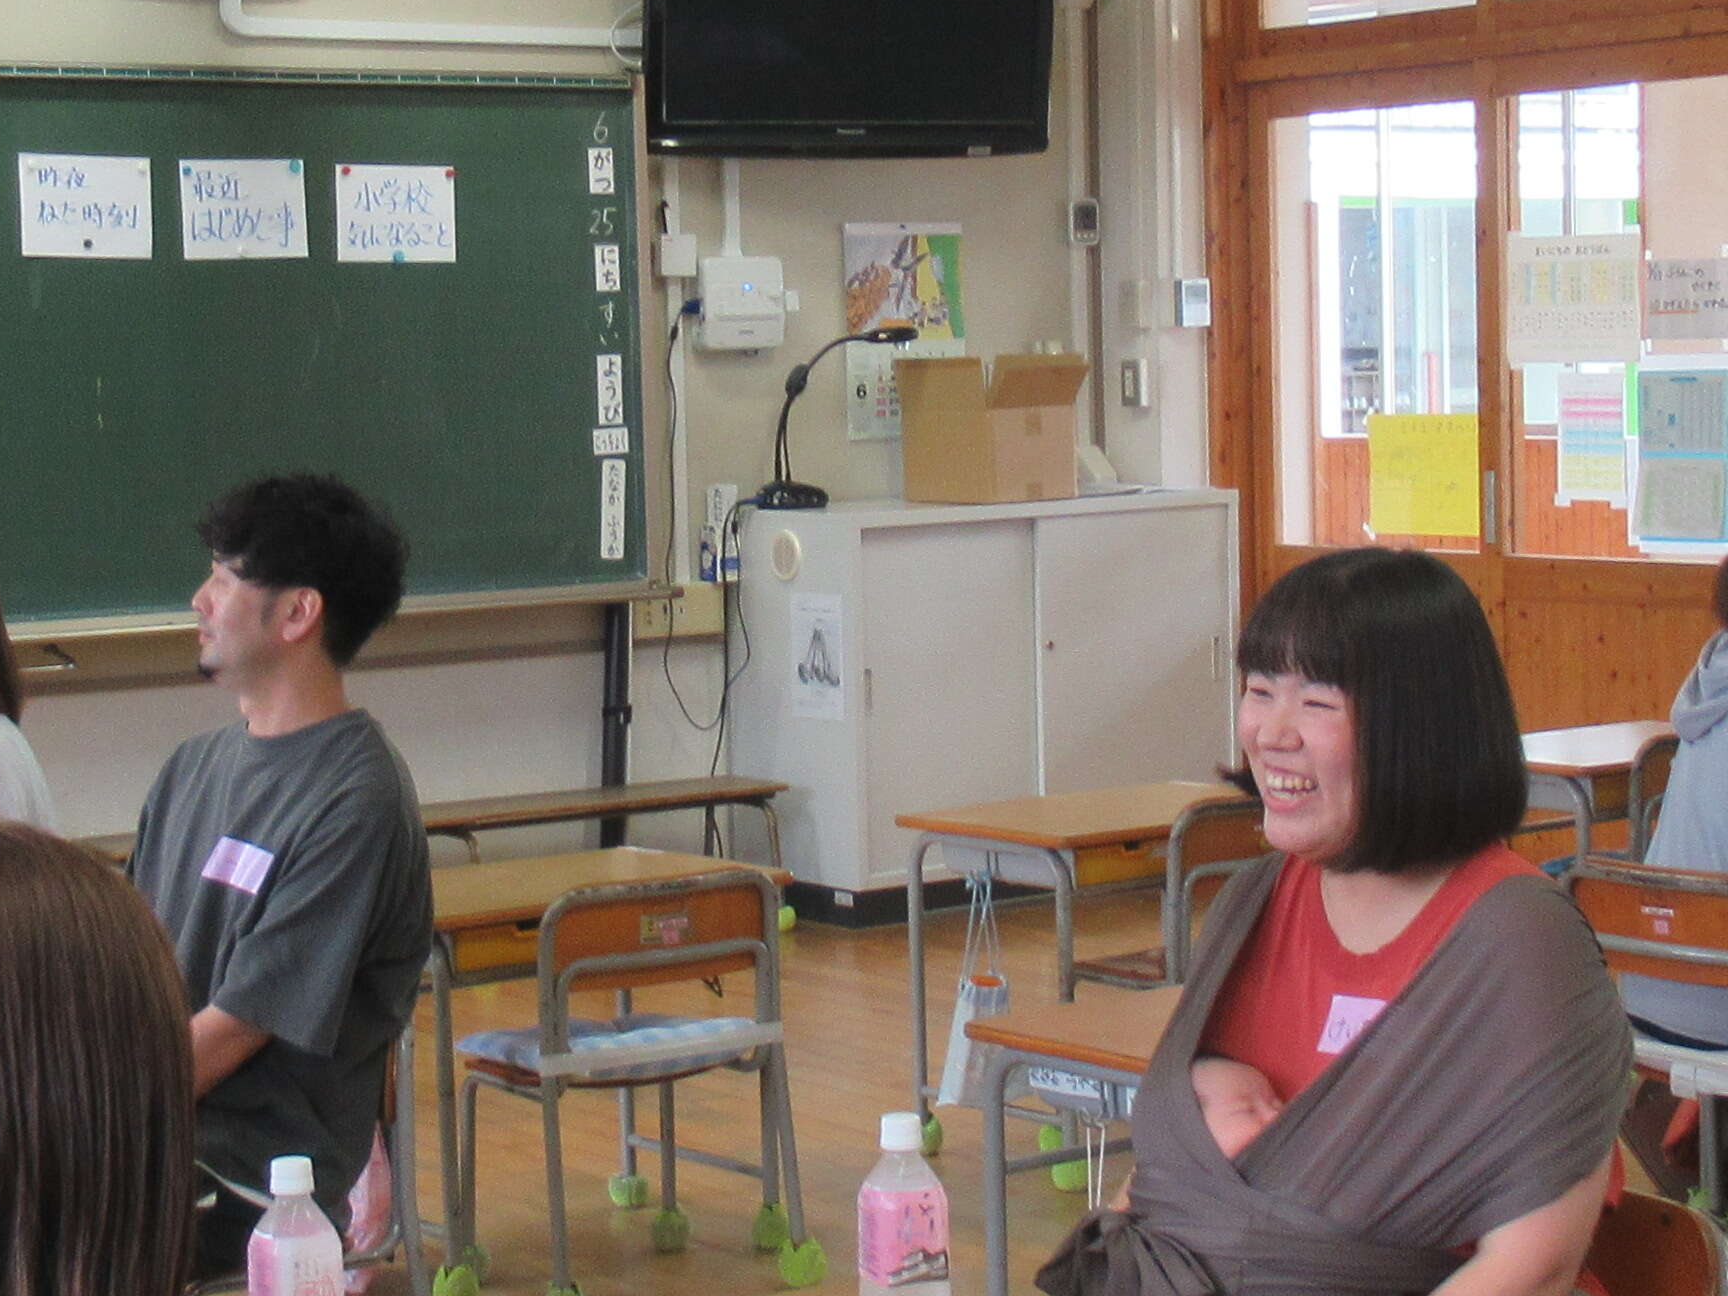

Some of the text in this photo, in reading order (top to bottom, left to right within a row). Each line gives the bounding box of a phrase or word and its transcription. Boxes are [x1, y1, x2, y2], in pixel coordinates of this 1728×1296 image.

[594, 111, 608, 143] 6
[593, 150, 612, 192] がつ
[354, 178, 434, 215] 小学校
[38, 200, 139, 229] ねた時刻
[589, 207, 617, 235] 25
[601, 248, 618, 291] にち
[603, 357, 621, 422] ようび
[856, 384, 867, 399] 6
